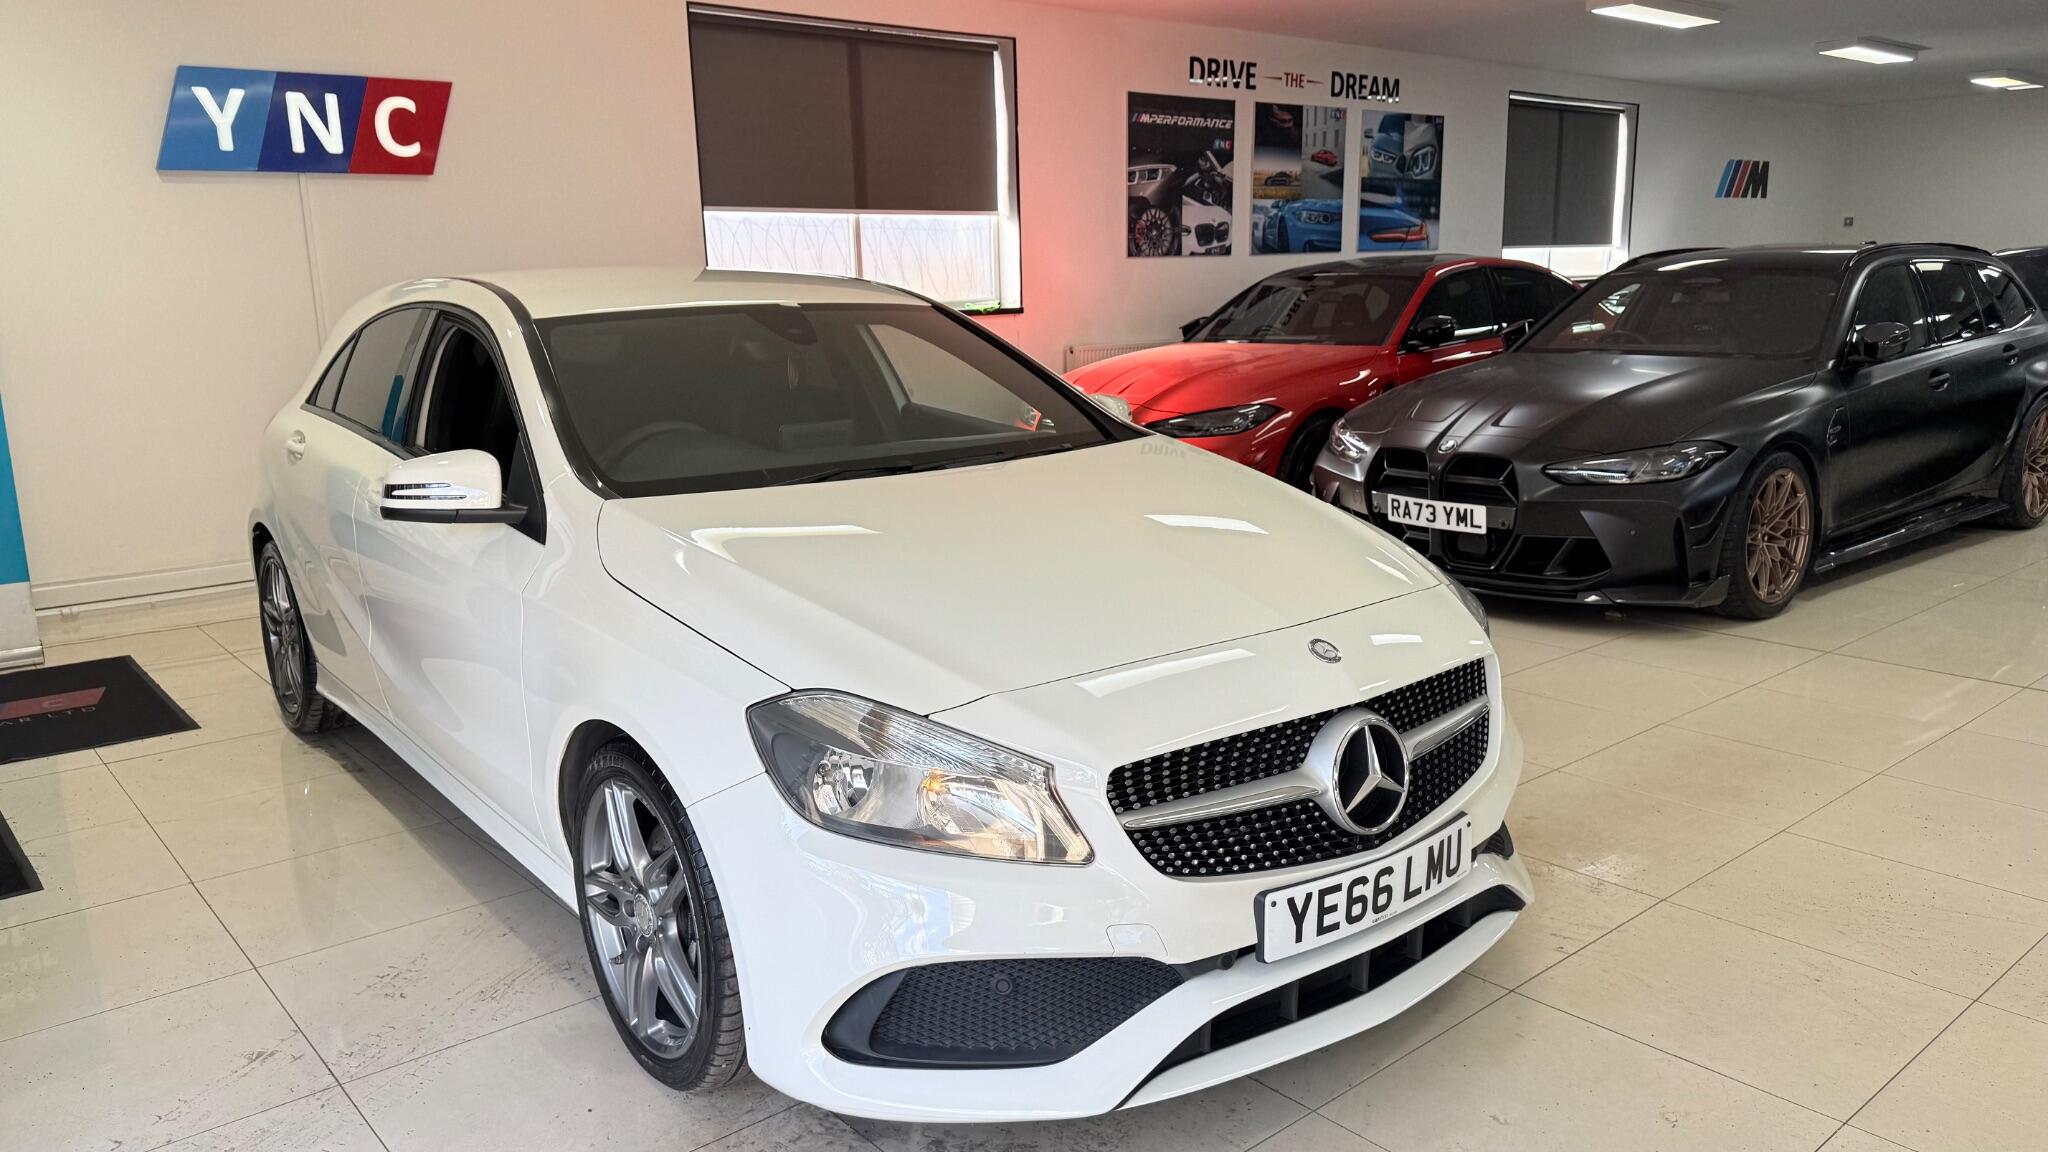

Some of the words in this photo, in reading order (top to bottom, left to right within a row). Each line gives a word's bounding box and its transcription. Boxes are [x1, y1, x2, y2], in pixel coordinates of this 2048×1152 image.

[1189, 56, 1257, 90] DRIVE
[1284, 72, 1305, 89] THE
[1330, 71, 1400, 102] DREAM
[191, 86, 421, 158] YNC
[1391, 498, 1437, 523] RA73
[1443, 505, 1482, 529] YML
[1287, 865, 1395, 944] YE66
[1403, 828, 1462, 902] LMU
